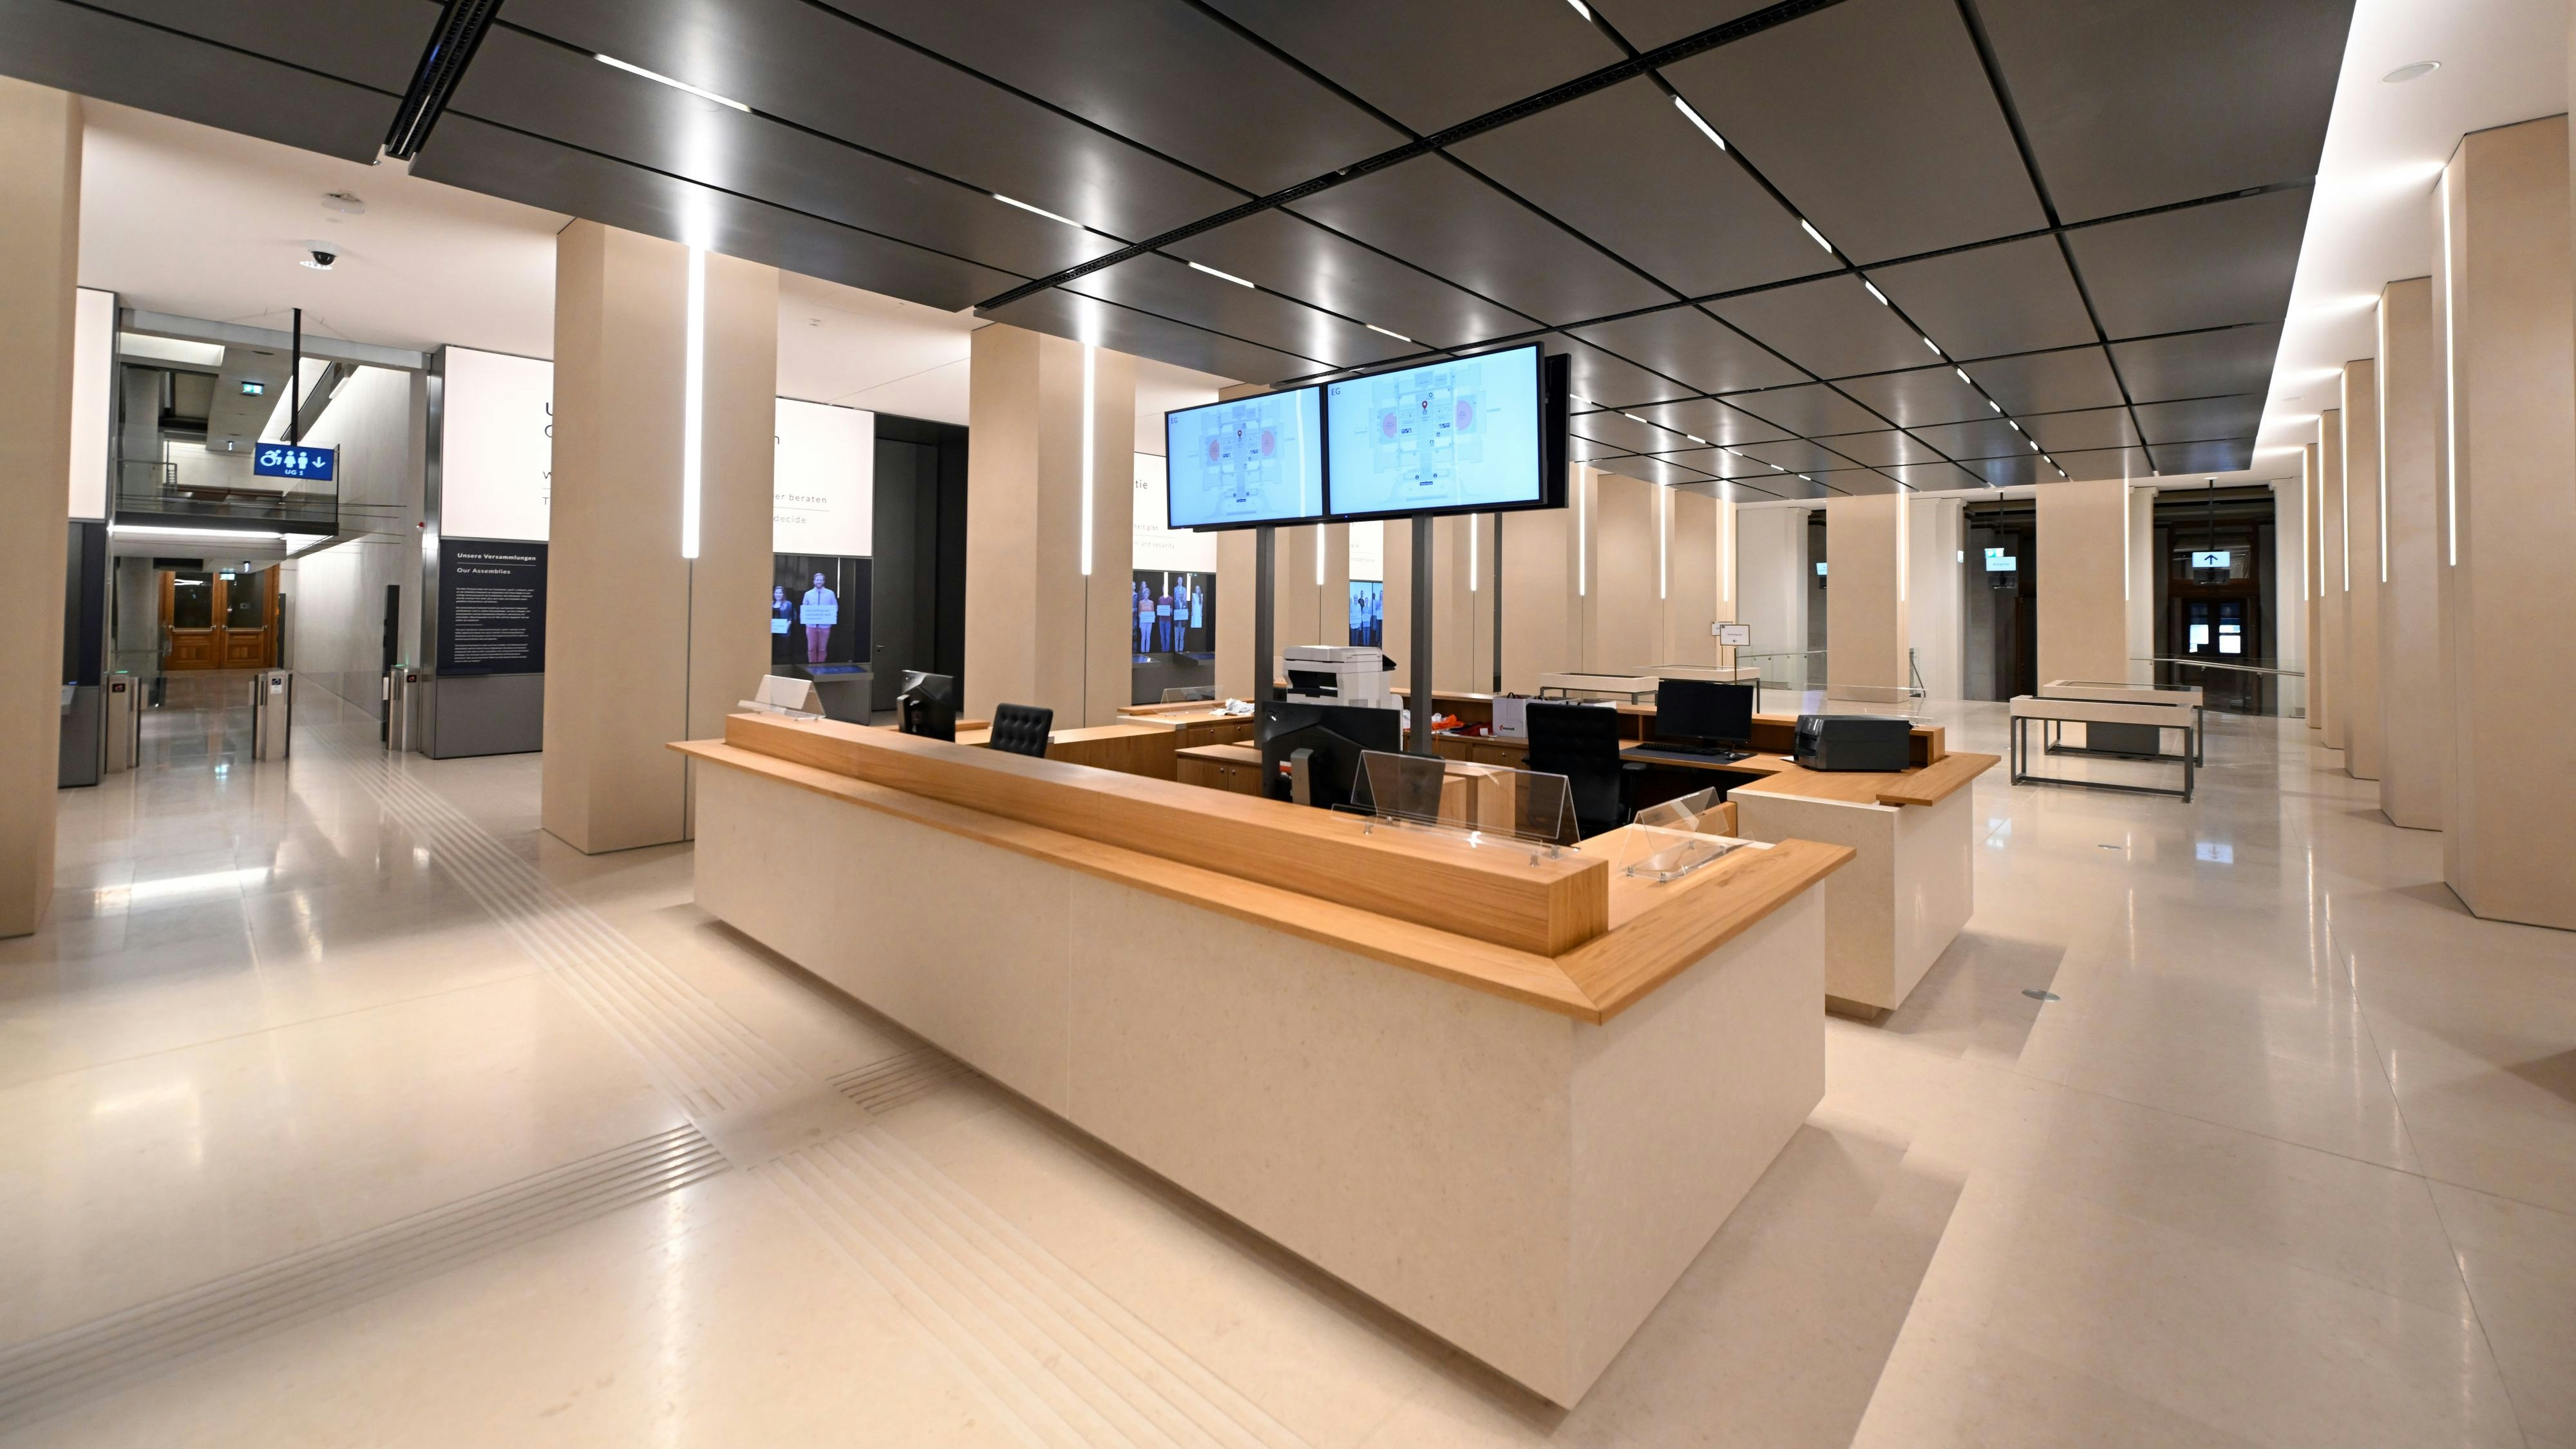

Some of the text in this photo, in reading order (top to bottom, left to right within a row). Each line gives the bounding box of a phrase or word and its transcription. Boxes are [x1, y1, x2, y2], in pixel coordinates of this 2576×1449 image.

[789, 493, 827, 503] beraten
[773, 515, 806, 524] decide
[483, 553, 536, 562] Versammlungen
